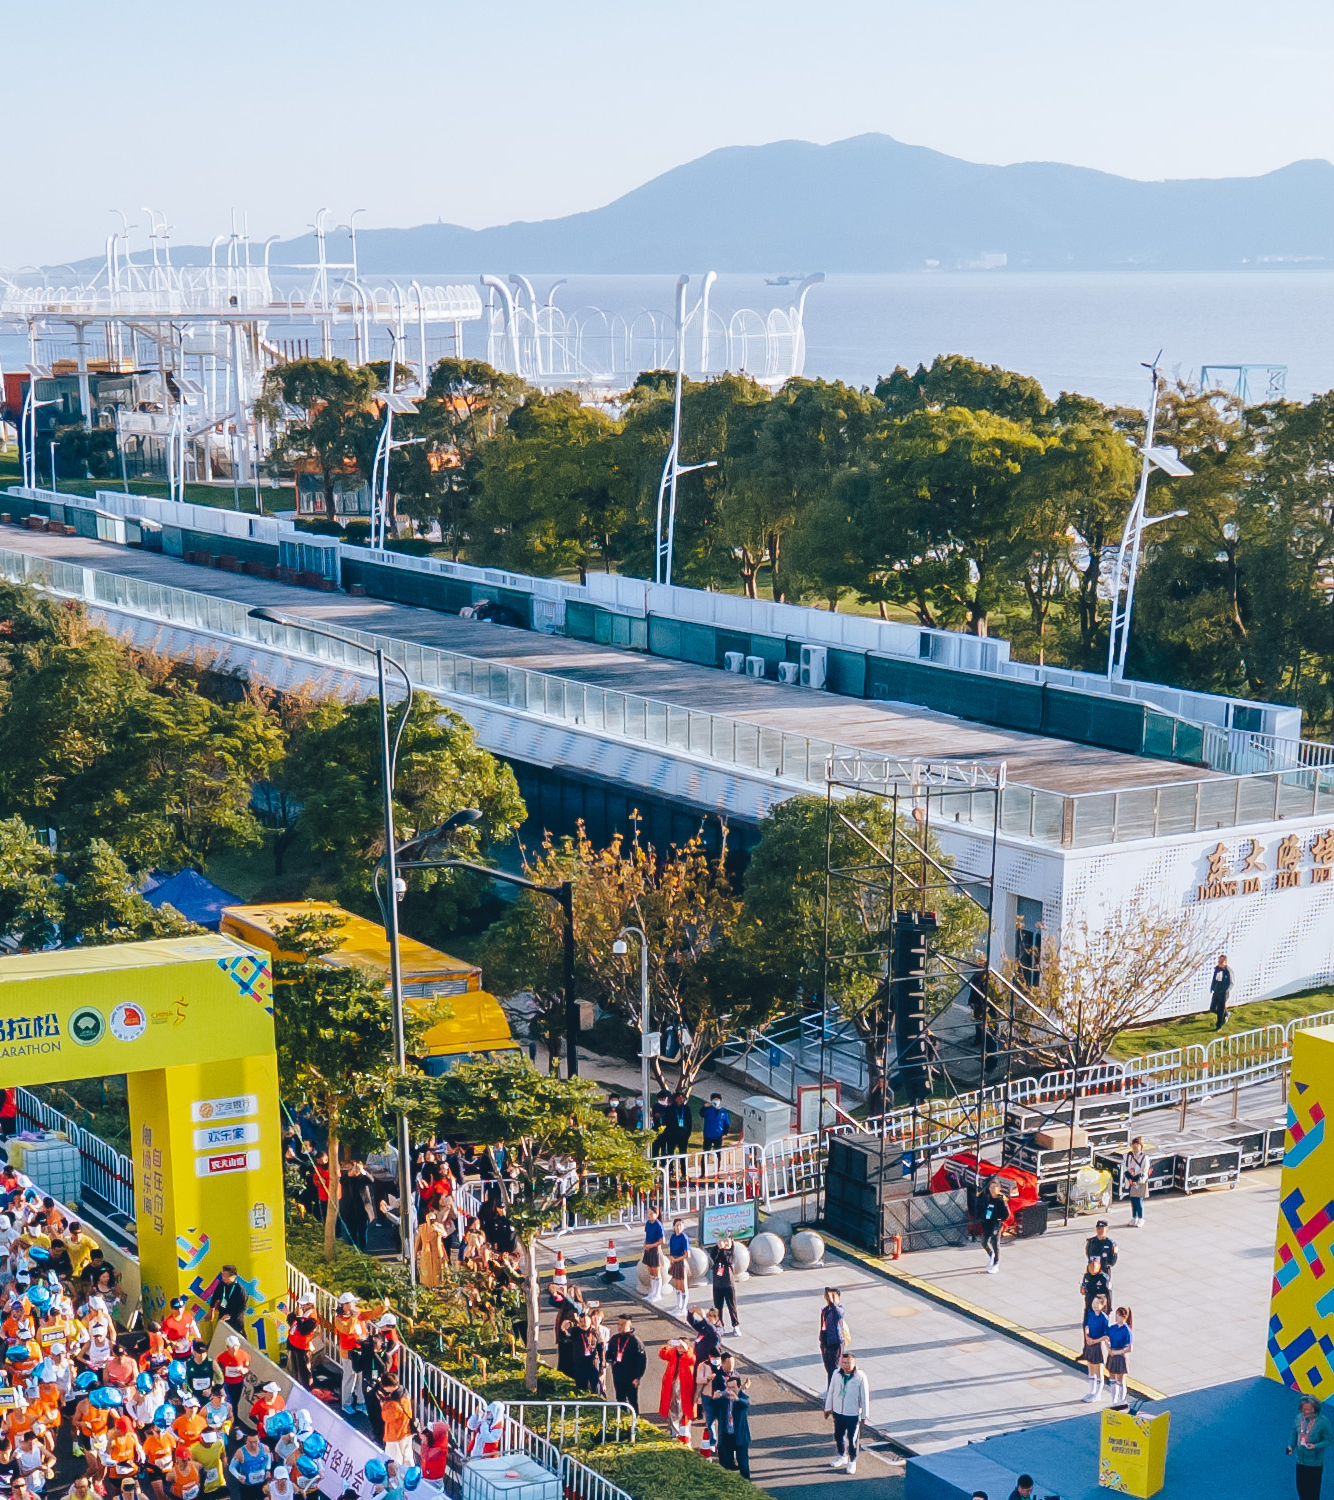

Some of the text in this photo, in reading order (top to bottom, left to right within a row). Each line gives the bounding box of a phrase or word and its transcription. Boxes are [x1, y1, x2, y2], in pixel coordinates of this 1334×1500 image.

[1242, 876, 1261, 895] DA
[1275, 870, 1302, 890] HAI
[215, 1099, 250, 1111] 宁波银行
[207, 1127, 245, 1144] 欢乐家
